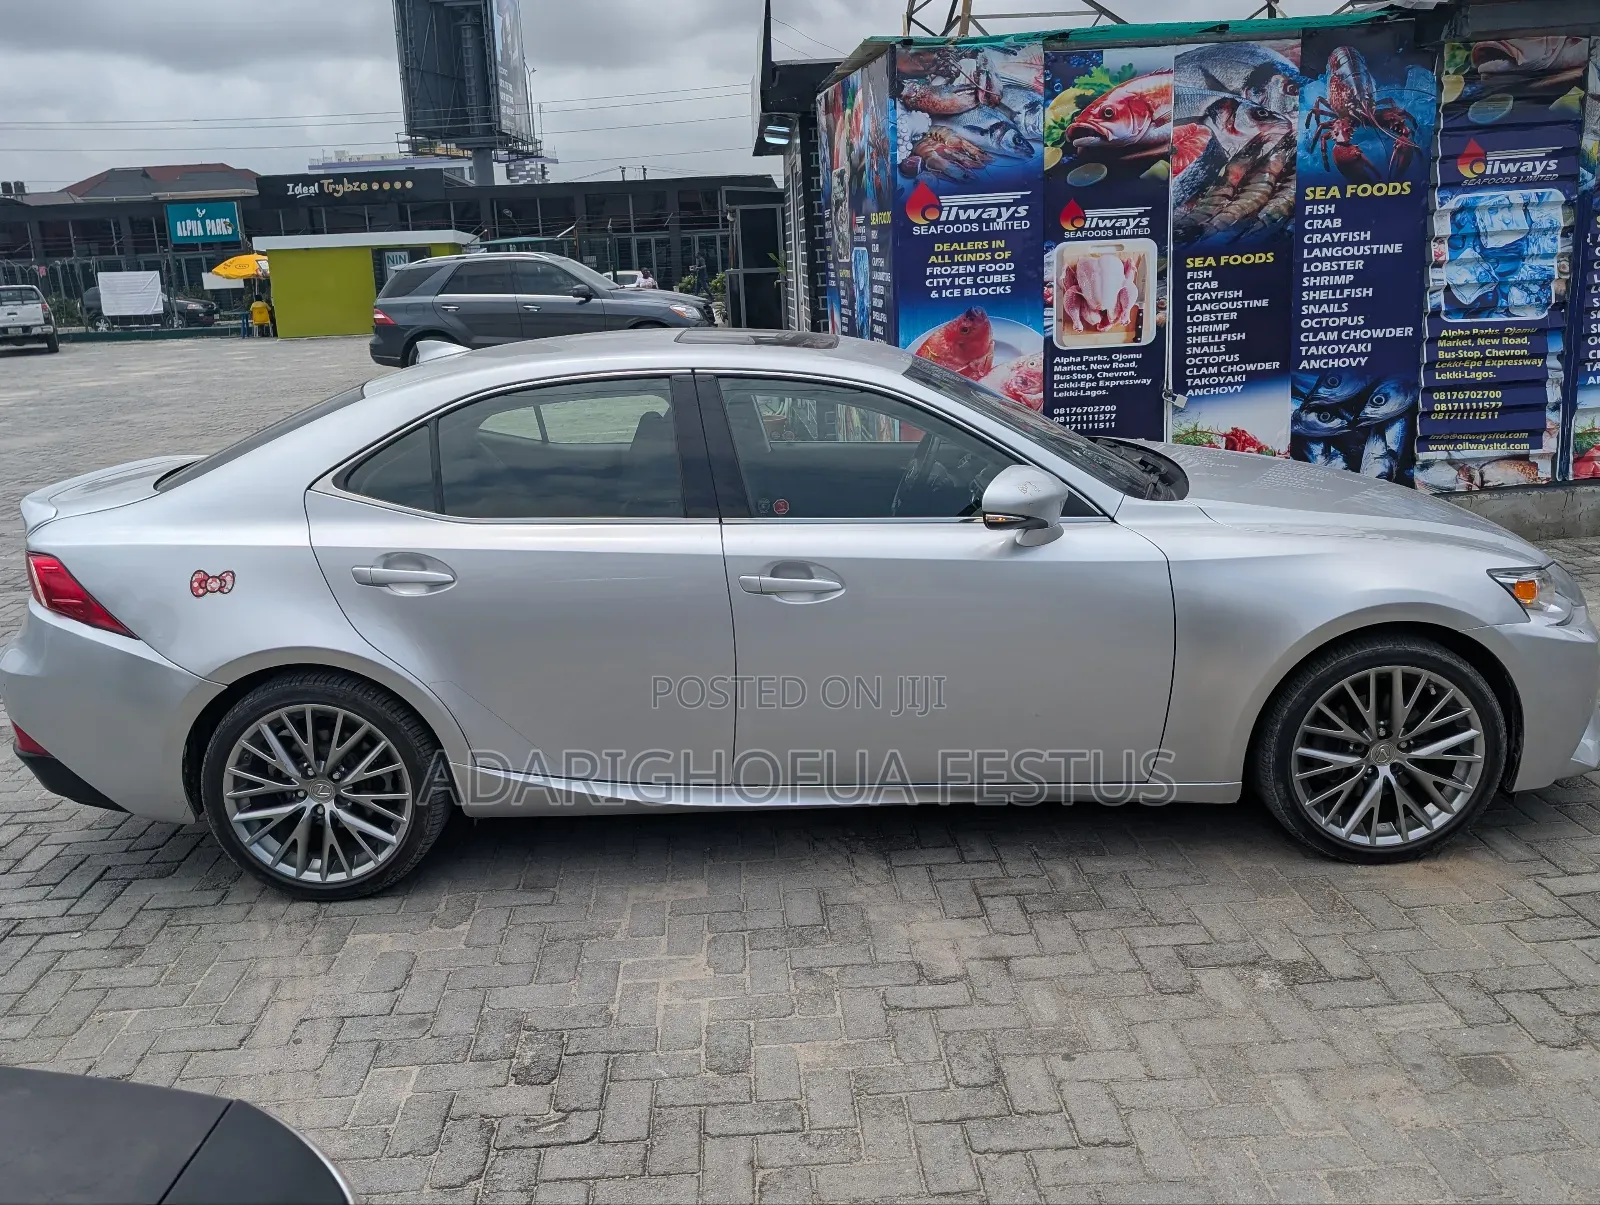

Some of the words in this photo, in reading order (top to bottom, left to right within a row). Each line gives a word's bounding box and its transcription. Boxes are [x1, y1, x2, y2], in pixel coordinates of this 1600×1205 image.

[1461, 176, 1517, 186] SEAFOODS
[1519, 174, 1559, 182] LIMITED
[287, 182, 318, 196] Ideal
[320, 178, 368, 197] Trybze
[1304, 186, 1341, 200] SEA
[1346, 181, 1411, 198] FOODS
[1305, 204, 1335, 215] FISH
[177, 220, 204, 236] ALPHA
[913, 223, 979, 235] SEAFOODS
[983, 221, 1030, 231] LIMITED
[1304, 219, 1342, 229] CRAB
[1064, 230, 1113, 238] SEAFOODS
[1304, 231, 1371, 244] CRAYFISH
[934, 241, 988, 252] DEALERS
[992, 240, 1004, 248] IN
[1303, 244, 1403, 258] LANGOUSTINE
[387, 254, 407, 265] NIN
[928, 255, 951, 263] ALL
[954, 252, 991, 262] KINDS
[994, 251, 1011, 259] OF
[1186, 257, 1216, 268] SEA
[1220, 253, 1274, 265] FOODS
[926, 264, 975, 275] FROZEN
[979, 262, 1014, 272] FOOD
[1303, 260, 1364, 272] LOBSTER
[926, 278, 952, 287] CITY
[955, 276, 974, 285] ICE
[977, 274, 1015, 284] CUBES
[1187, 271, 1212, 279] FISH
[1302, 275, 1354, 286] SHRIMP
[1187, 281, 1218, 290] CRAB
[931, 290, 938, 298] &
[942, 288, 960, 297] ICE
[964, 286, 1011, 296] BLOCKS
[1187, 290, 1242, 301] CRAYFISH
[1301, 288, 1373, 301] SHELLFISH
[1187, 299, 1269, 312] LANGOUSTINE
[1301, 303, 1348, 314] SNAILS
[1187, 312, 1237, 322] LOBSTER
[1301, 316, 1364, 328] OCTOPUS
[1186, 324, 1230, 333] SHRIMP
[1441, 329, 1470, 338] Alpha
[1504, 327, 1538, 335] Ojomu
[1186, 333, 1245, 344] SHELLFISH
[1300, 331, 1338, 342] CLAM
[1342, 327, 1413, 340] CHOWDER
[1438, 339, 1474, 347] Market,
[1477, 338, 1500, 346] New
[1502, 337, 1530, 345] Road,
[1186, 345, 1226, 354] SNAILS
[1300, 343, 1372, 355] TAKOYAKI
[1438, 350, 1483, 358] Bus-Stop,
[1053, 356, 1080, 364] Alpha
[1082, 354, 1109, 362] Parks,
[1112, 353, 1142, 361] Ojomu
[1186, 354, 1240, 365] OCTOPUS
[1299, 357, 1368, 370] ANCHOVY
[1436, 359, 1482, 369] Lekki-Epe
[1485, 358, 1543, 368] Expressway
[1054, 364, 1088, 372] Market,
[1221, 362, 1280, 373] CHOWDER
[1186, 375, 1246, 386] TAKOYAKI
[1436, 371, 1496, 380] Lekki-Lagos.
[1054, 379, 1096, 389] Lekki-Epe
[1099, 378, 1152, 386] Expressway
[1186, 385, 1243, 396] ANCHOVY
[1433, 391, 1501, 400] 08176702700
[1054, 405, 1116, 414] 08176702700
[1434, 402, 1502, 411] 08171111577
[1054, 414, 1116, 423] 08171111577
[1066, 422, 1115, 430] 171111511
[1429, 433, 1528, 441] info@oilwaysltd.com
[1429, 442, 1529, 450] www.oilwaysltd.com
